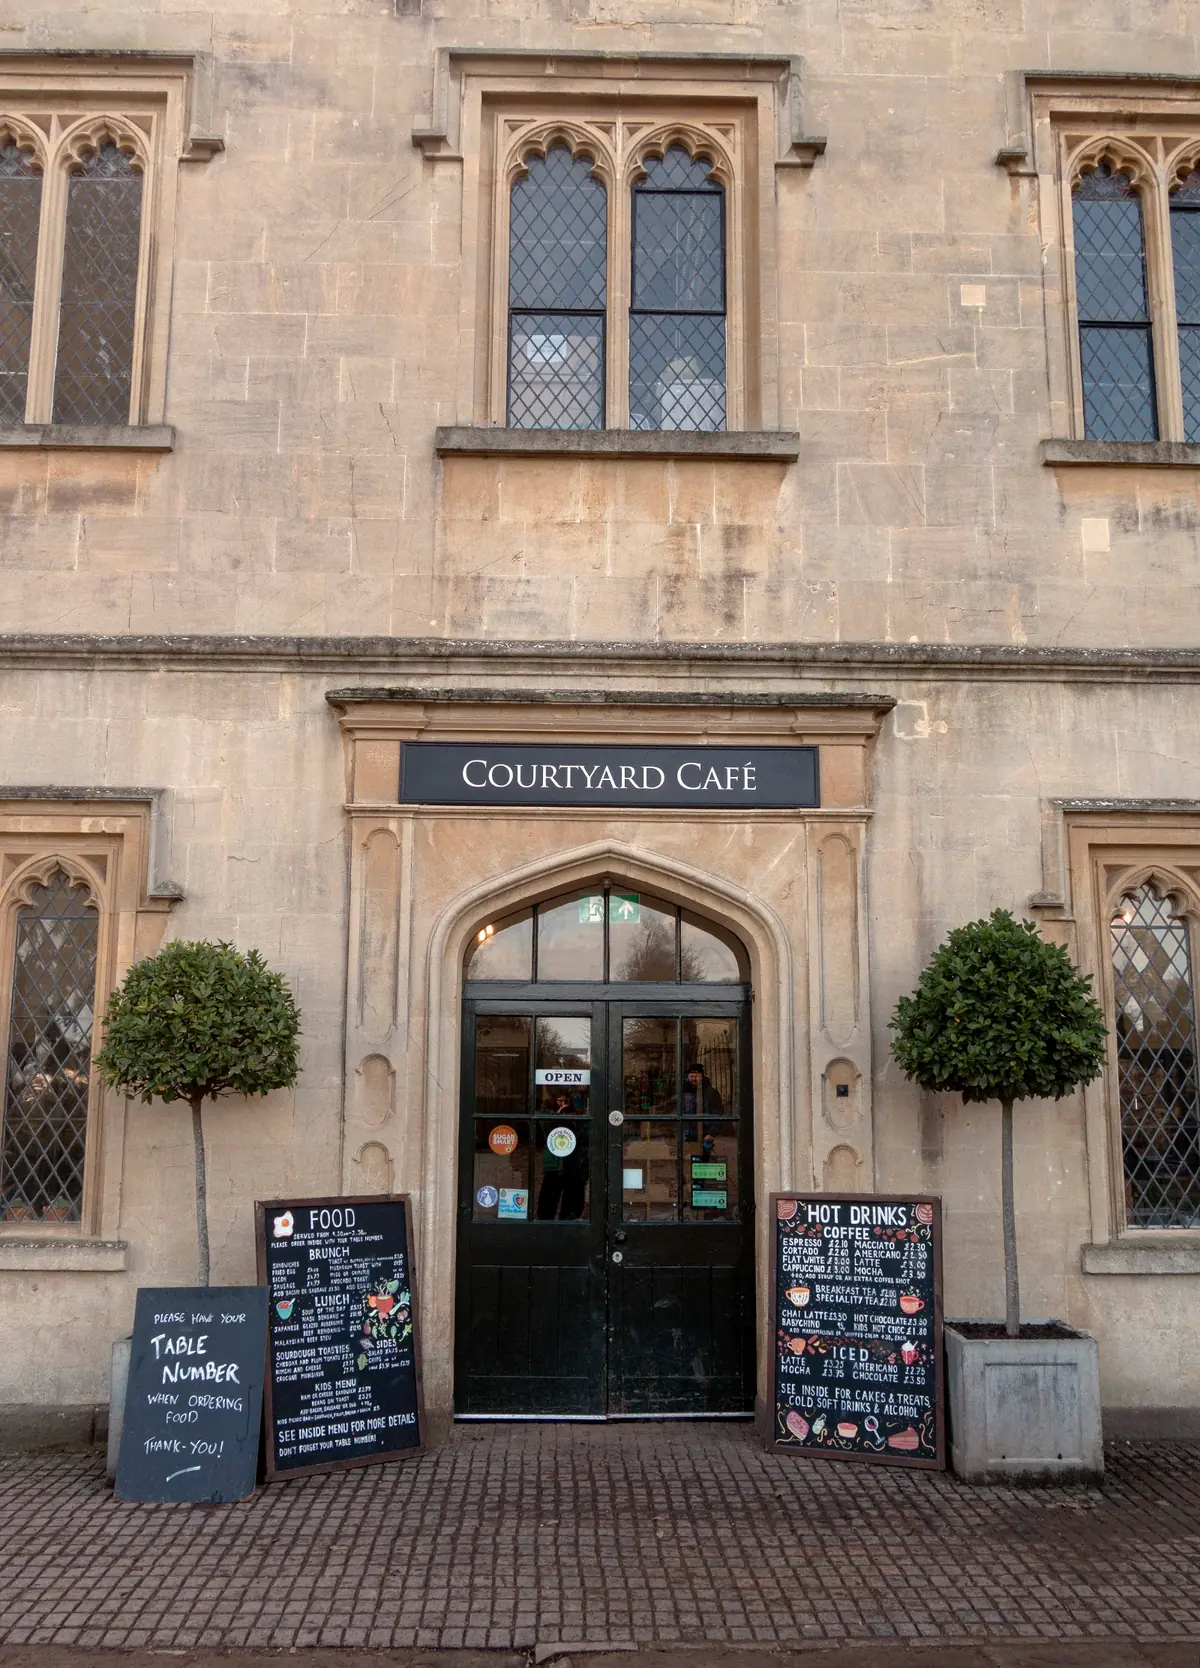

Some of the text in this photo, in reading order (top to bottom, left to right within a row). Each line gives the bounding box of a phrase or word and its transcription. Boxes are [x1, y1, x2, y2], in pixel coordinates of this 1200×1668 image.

[463, 760, 665, 789] COURTYARD
[545, 1073, 583, 1082] OPEN
[310, 1208, 356, 1229] FOOD
[808, 1205, 907, 1226] HOT DRINKS
[824, 1227, 870, 1239] COFFEE
[783, 1238, 822, 1246] ESPRESSO
[854, 1241, 895, 1249] MACCIATO
[310, 1246, 350, 1260] BRUNCH
[783, 1247, 818, 1255] CORTADO
[854, 1251, 900, 1259] AMERICANO
[783, 1256, 800, 1264] FLAT
[854, 1259, 880, 1267] LATTE
[783, 1265, 825, 1273] CAPPUCCINO
[854, 1267, 883, 1276] MOCHA
[273, 1282, 295, 1290] SAUSAGE
[816, 1285, 859, 1295] BREAKFAST
[862, 1288, 876, 1296] TEA
[315, 1294, 350, 1306] LUNCH
[816, 1294, 862, 1304] SPECIALITY
[865, 1297, 879, 1306] TEA
[154, 1313, 246, 1324] PLEASE HAVE YOUR
[782, 1309, 829, 1320] CHAI LATTE
[854, 1314, 907, 1325] HOT CHOCOLATE
[274, 1325, 299, 1333] JAPANESE
[320, 1320, 343, 1328] AUBERGINE
[782, 1319, 820, 1328] BABYCHINO
[873, 1324, 885, 1333] HOT
[888, 1326, 905, 1334] CHOC
[151, 1334, 208, 1359] TABLE
[376, 1339, 396, 1348] SIDES
[276, 1345, 350, 1360] SOURDOUGH TOASTIES
[833, 1347, 868, 1361] ICED
[276, 1360, 298, 1368] CHEDDAR
[781, 1356, 805, 1366] LATTE
[162, 1362, 240, 1384] NUMBER
[781, 1366, 810, 1375] MOCHA
[853, 1363, 898, 1373] AMERICANO
[853, 1371, 898, 1383] CHOCOLATE
[315, 1379, 356, 1391] KIDS MENU
[336, 1388, 356, 1396] SANDWICH
[781, 1384, 796, 1394] SEE
[802, 1385, 828, 1397] INSIDE
[835, 1388, 851, 1399] FOR
[856, 1390, 886, 1403] CAKES
[888, 1393, 894, 1403] &
[147, 1394, 242, 1412] WHEN ORDERING
[789, 1396, 918, 1418] COLD SOFT DRINKS & ALCOHOL
[166, 1411, 198, 1423] FOOD
[279, 1413, 415, 1443] SEE INSIDE MENU FOR MORE DETAILS
[279, 1434, 376, 1456] DON'T FORGET YOUR TABLE NUMBER!
